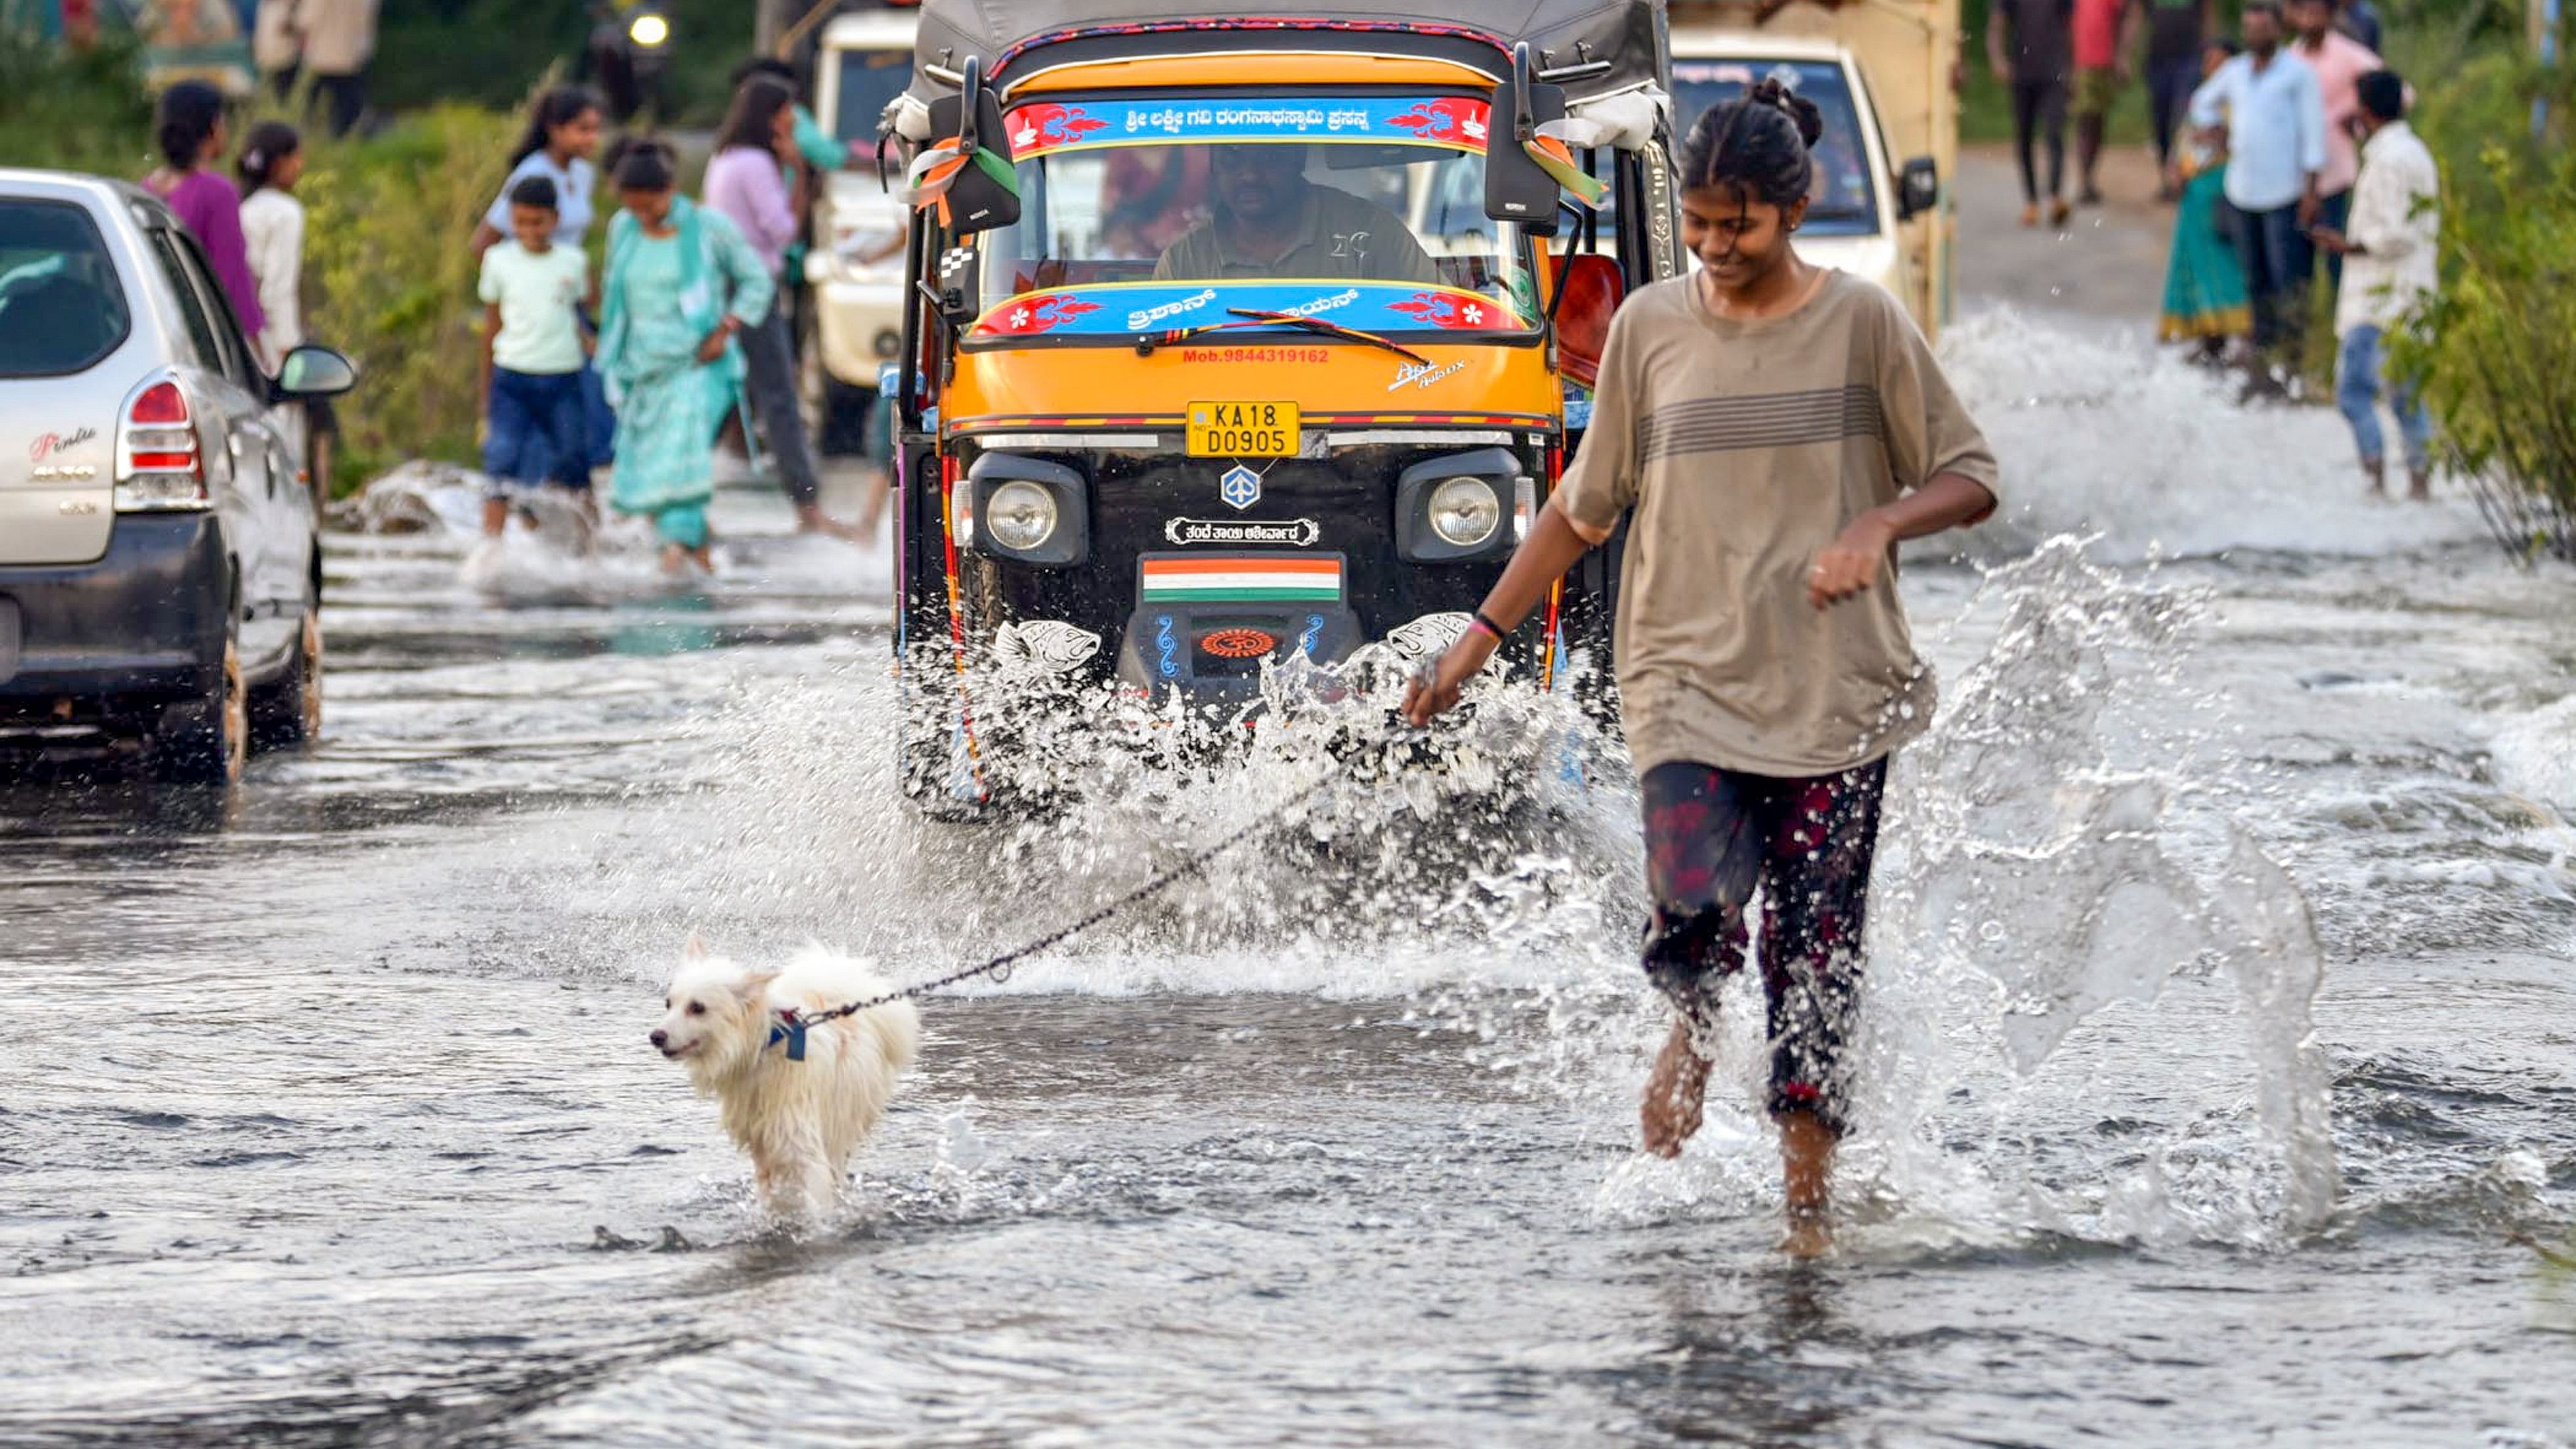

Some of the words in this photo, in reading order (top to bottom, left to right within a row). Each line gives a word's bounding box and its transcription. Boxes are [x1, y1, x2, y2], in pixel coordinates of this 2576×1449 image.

[1125, 110, 1147, 132] ಶ್ರೀ
[1187, 109, 1212, 125] ಗವಿ
[1216, 108, 1323, 131] ರಂಗನಾಥಸ್ವಾಮಿ
[1328, 108, 1369, 131] ಪ್ರಸನ್ನ
[1183, 349, 1329, 364] Mob.9844319162
[1209, 430, 1285, 452] D0905
[1186, 524, 1212, 540] ತಂದೆ
